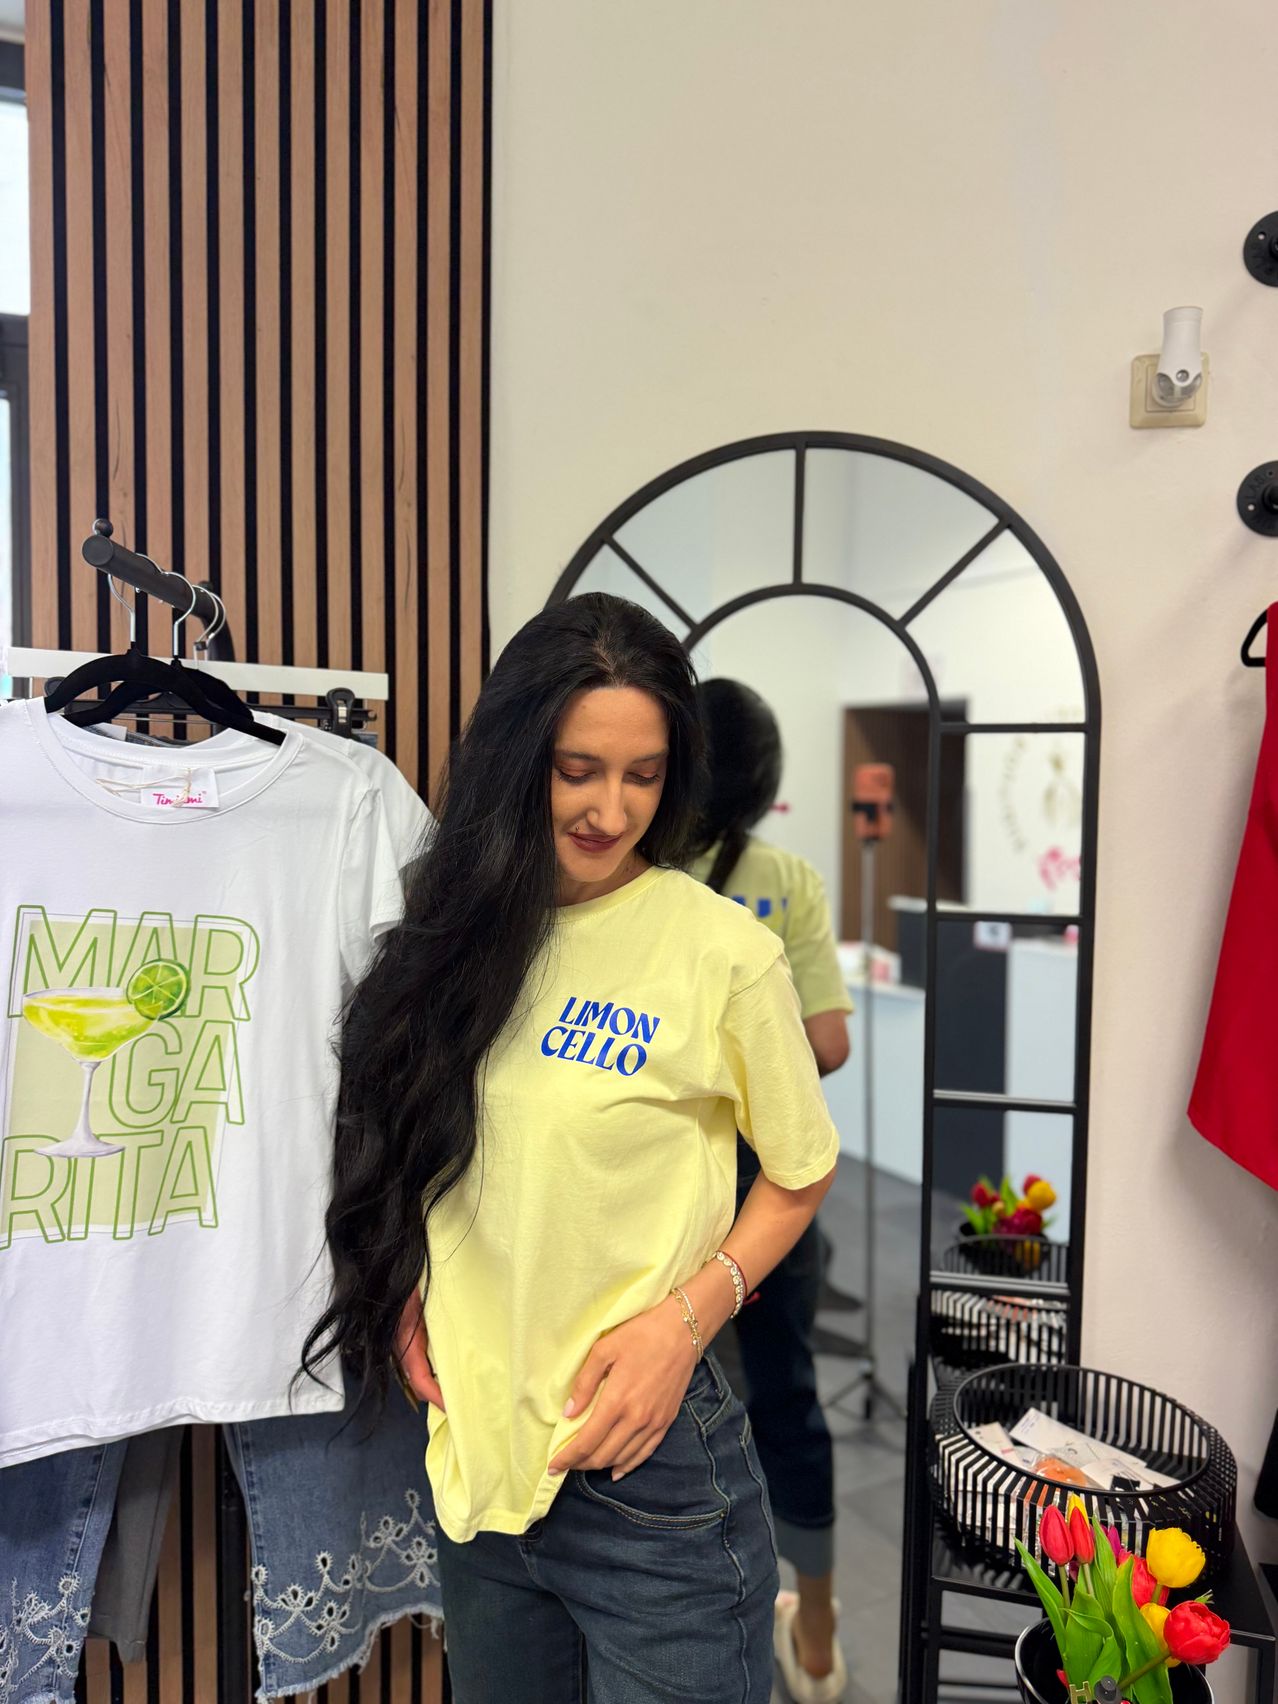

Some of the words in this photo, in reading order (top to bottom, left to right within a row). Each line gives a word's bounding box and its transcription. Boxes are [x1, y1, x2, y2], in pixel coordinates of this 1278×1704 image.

[7, 905, 260, 1021] MAR
[108, 1019, 245, 1129] GA
[540, 1025, 648, 1077] CELLO
[558, 996, 661, 1044] LIMON
[0, 1126, 219, 1251] RITA
